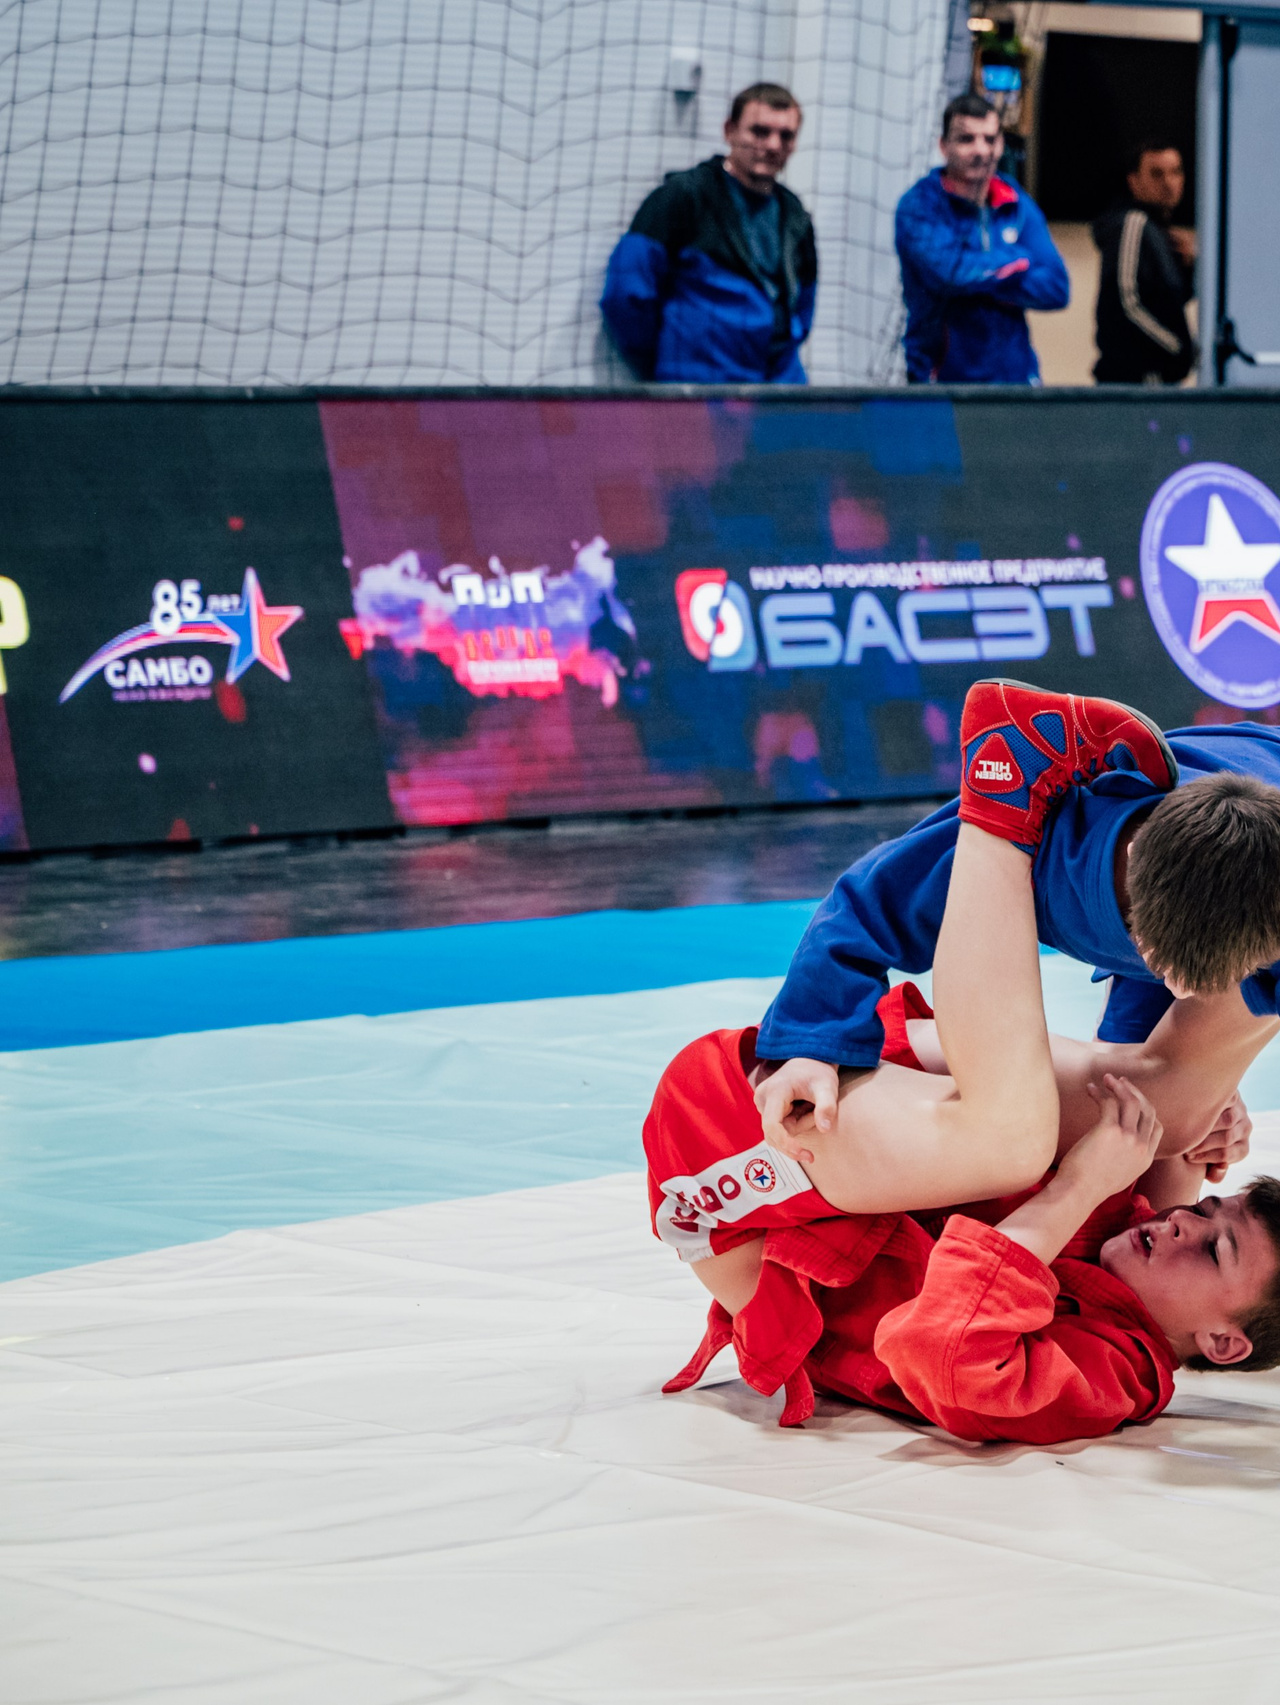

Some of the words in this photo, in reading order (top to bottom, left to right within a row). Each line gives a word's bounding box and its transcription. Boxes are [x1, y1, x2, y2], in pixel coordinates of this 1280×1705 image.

[152, 578, 202, 636] 85
[759, 584, 1113, 669] БАСЭТ
[103, 655, 213, 688] САМБО
[975, 770, 1013, 781] GREEN
[978, 760, 1010, 773] HILL
